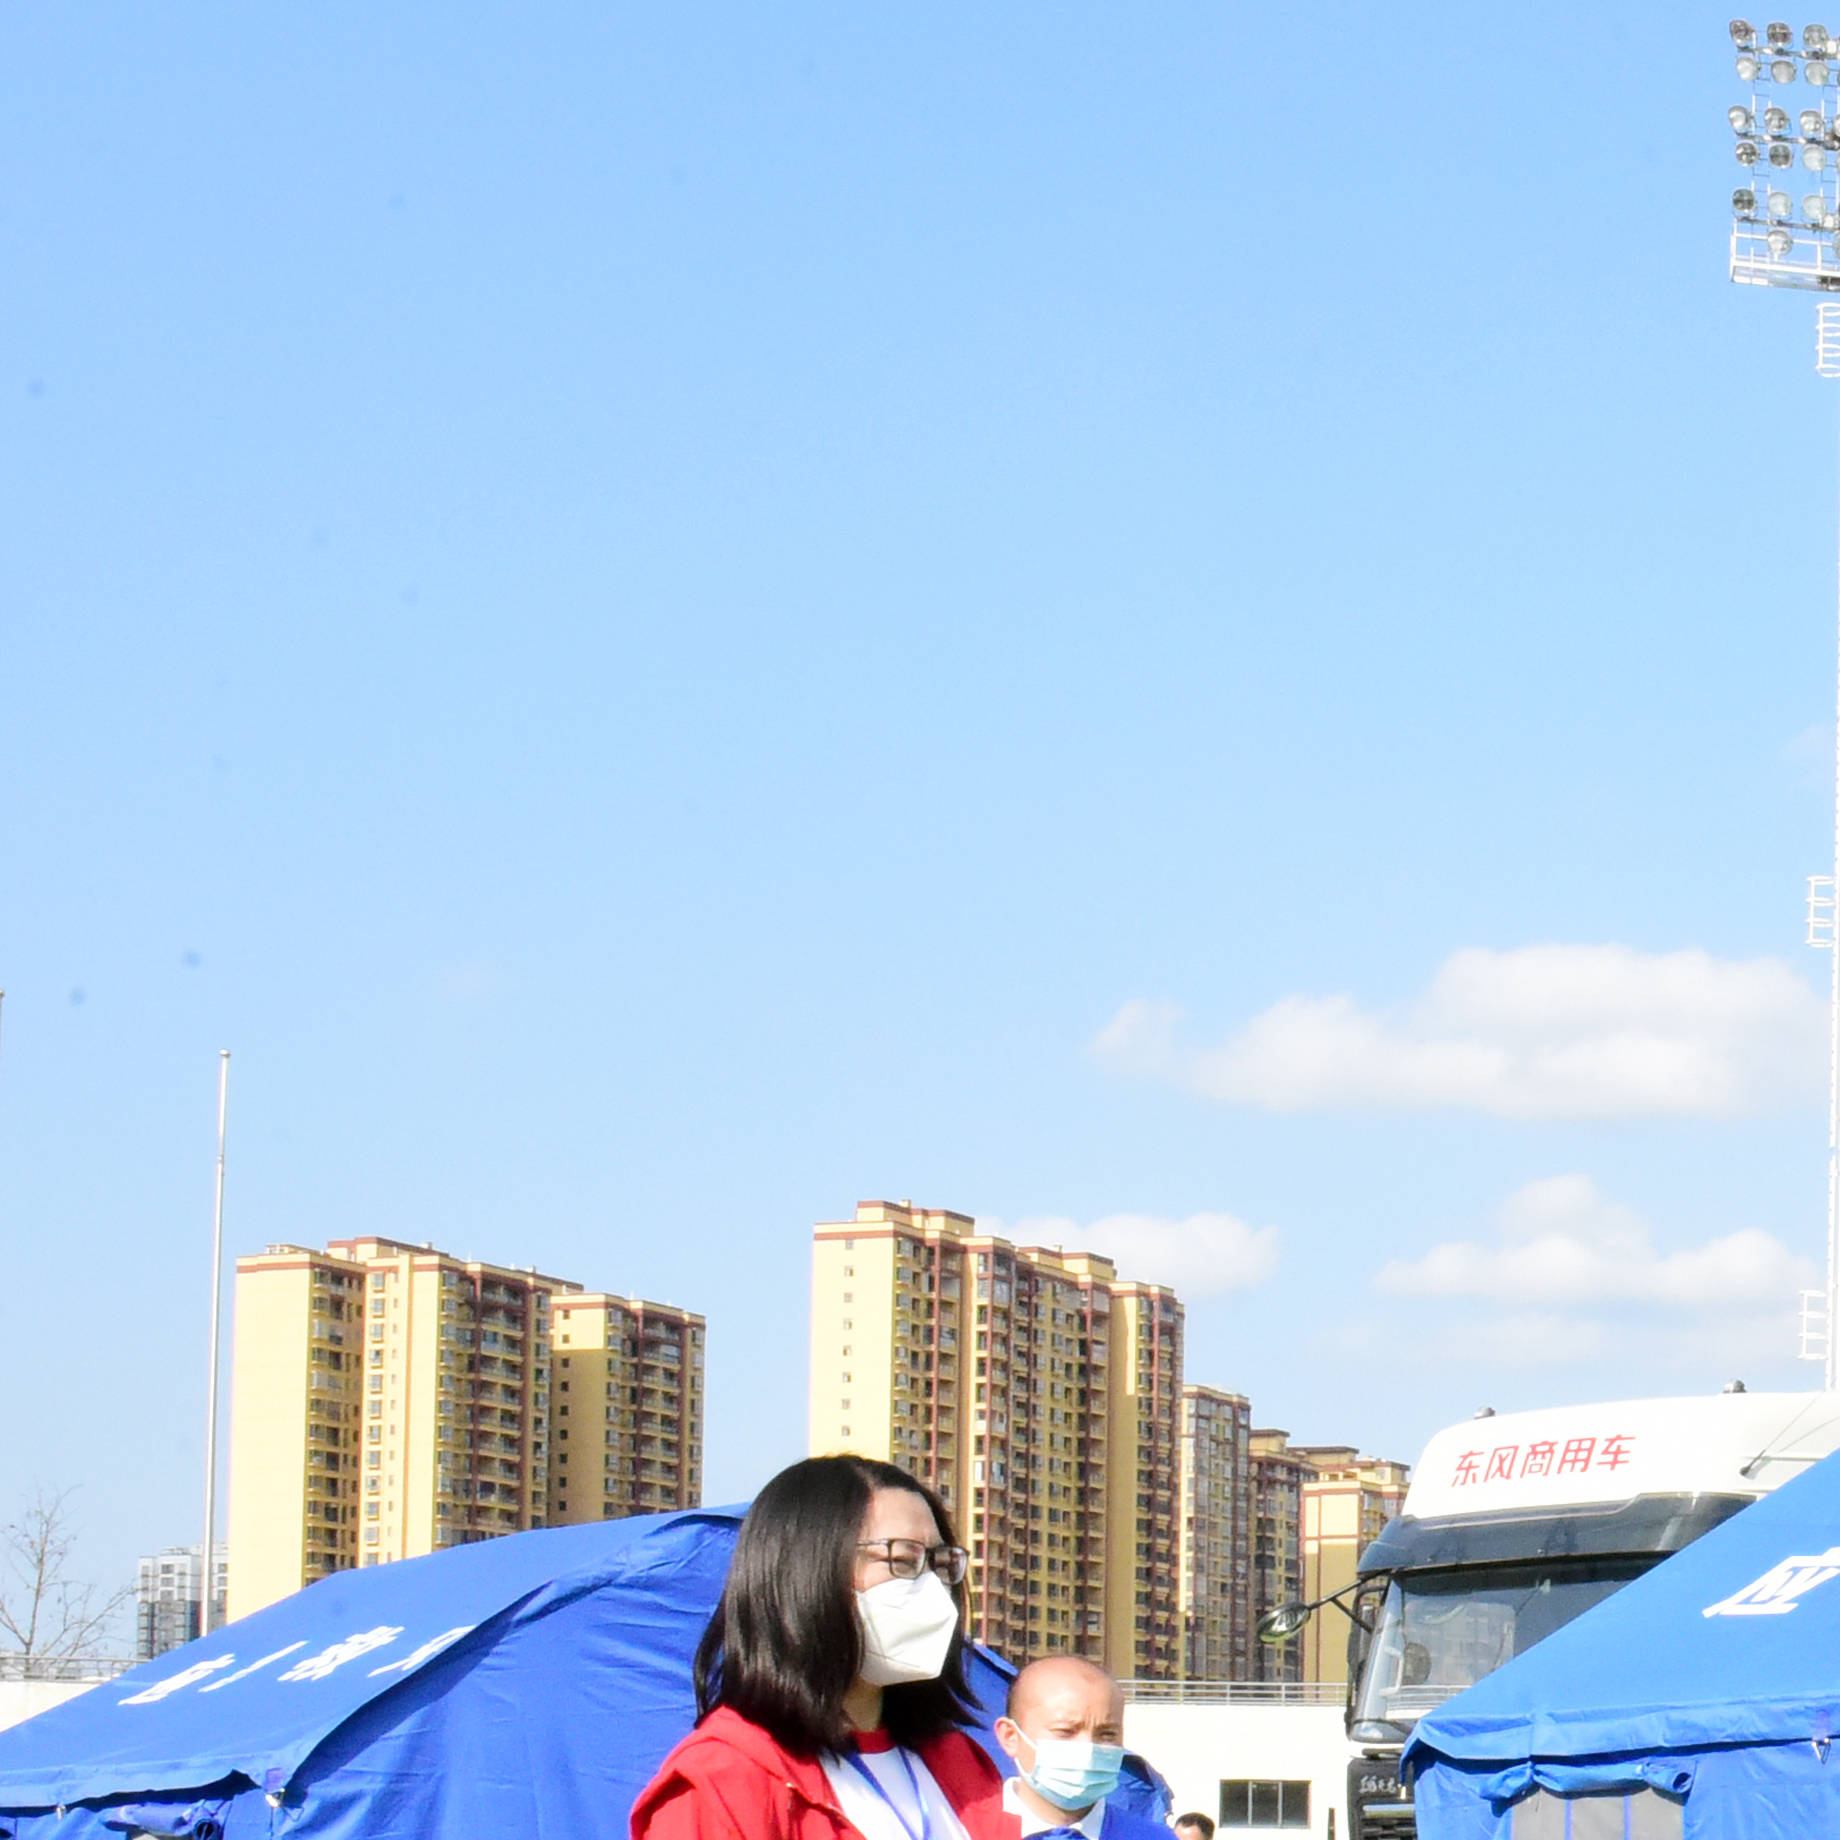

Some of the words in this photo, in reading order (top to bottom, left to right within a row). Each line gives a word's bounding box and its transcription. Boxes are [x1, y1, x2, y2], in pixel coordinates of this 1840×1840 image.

[1451, 1433, 1636, 1487] 东风商用车
